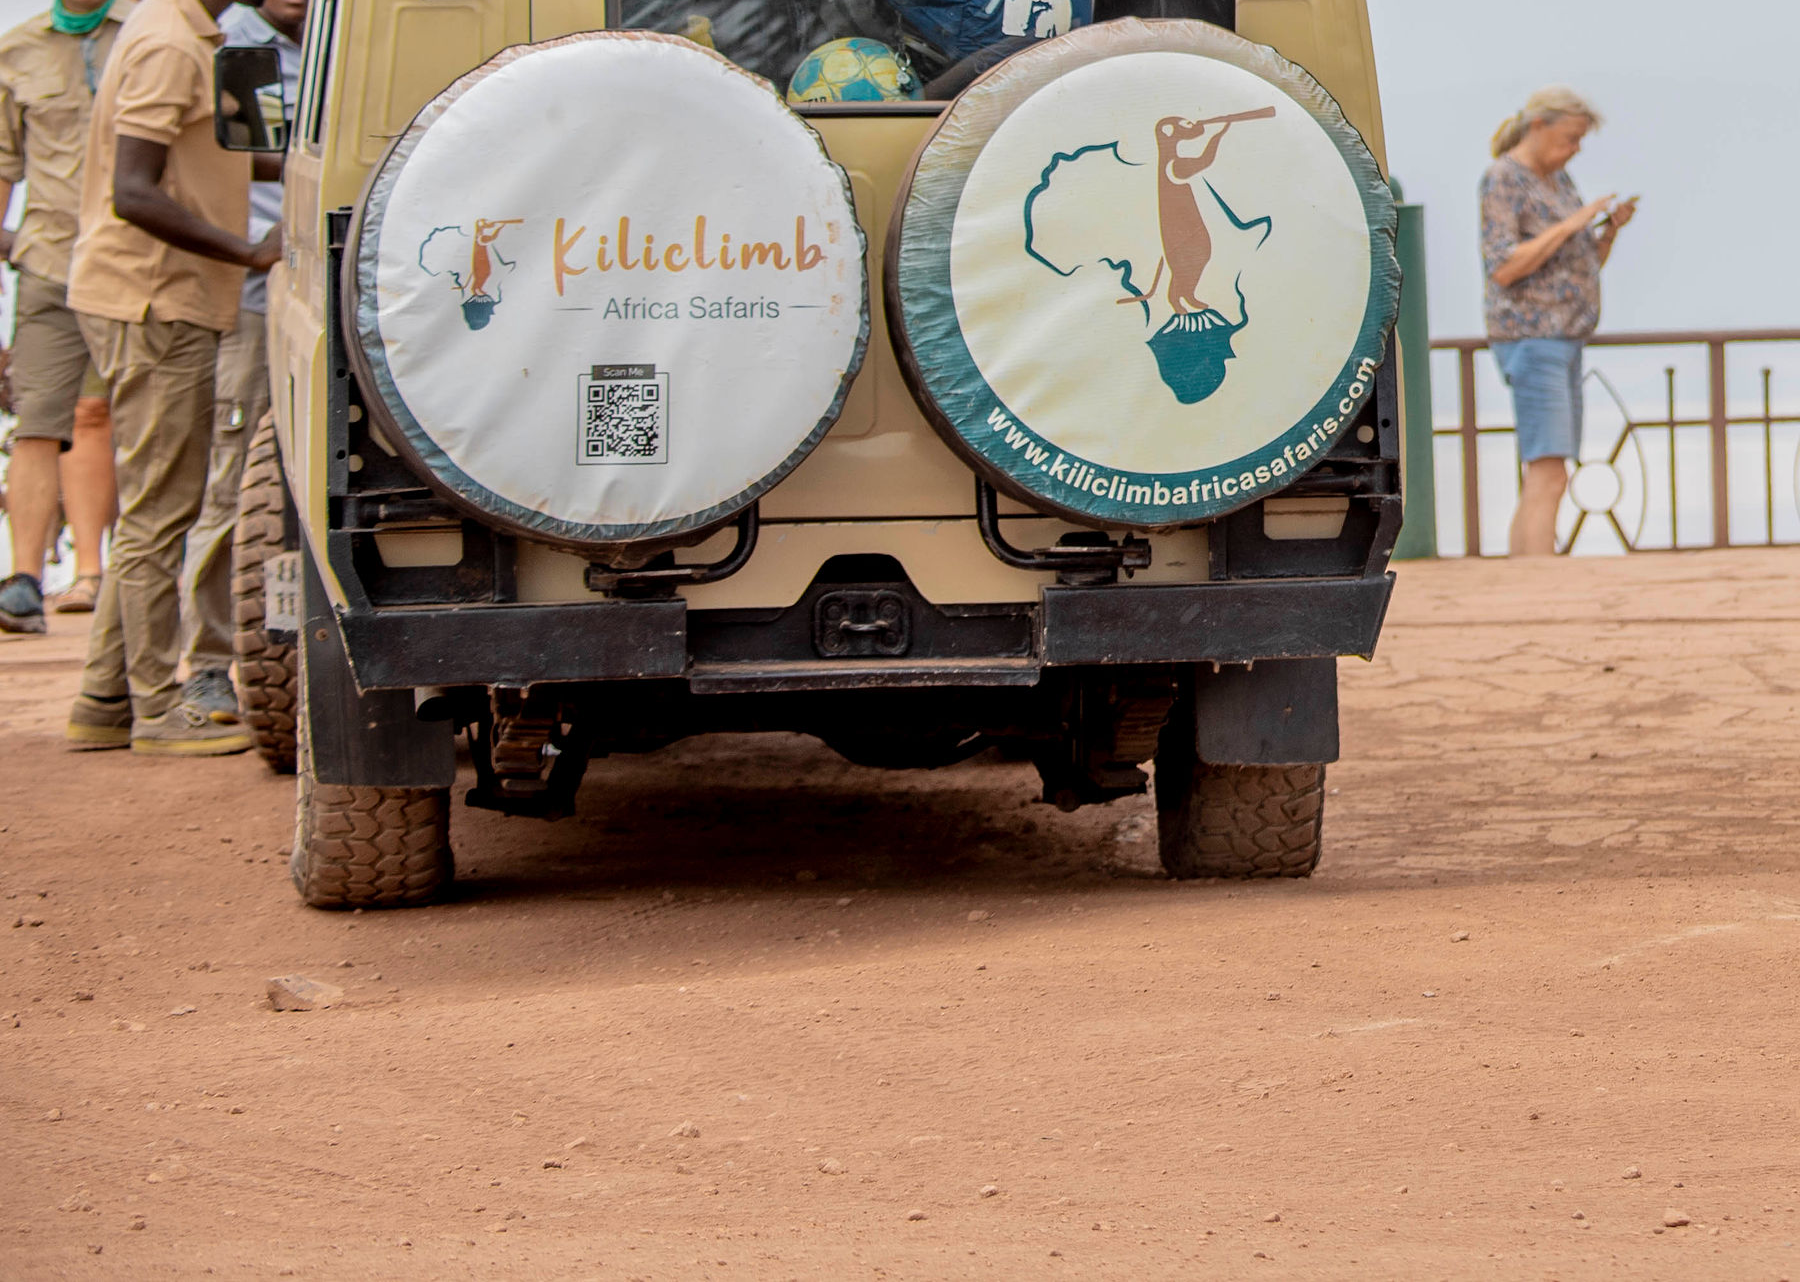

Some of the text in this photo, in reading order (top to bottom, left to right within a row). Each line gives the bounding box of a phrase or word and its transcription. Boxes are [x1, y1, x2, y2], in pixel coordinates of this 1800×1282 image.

[554, 215, 827, 296] Kiliclimb
[603, 296, 780, 319] Africa Safaris
[603, 367, 645, 377] Scan Me
[986, 356, 1376, 506] www.kiliclimbafricasafaris.com
